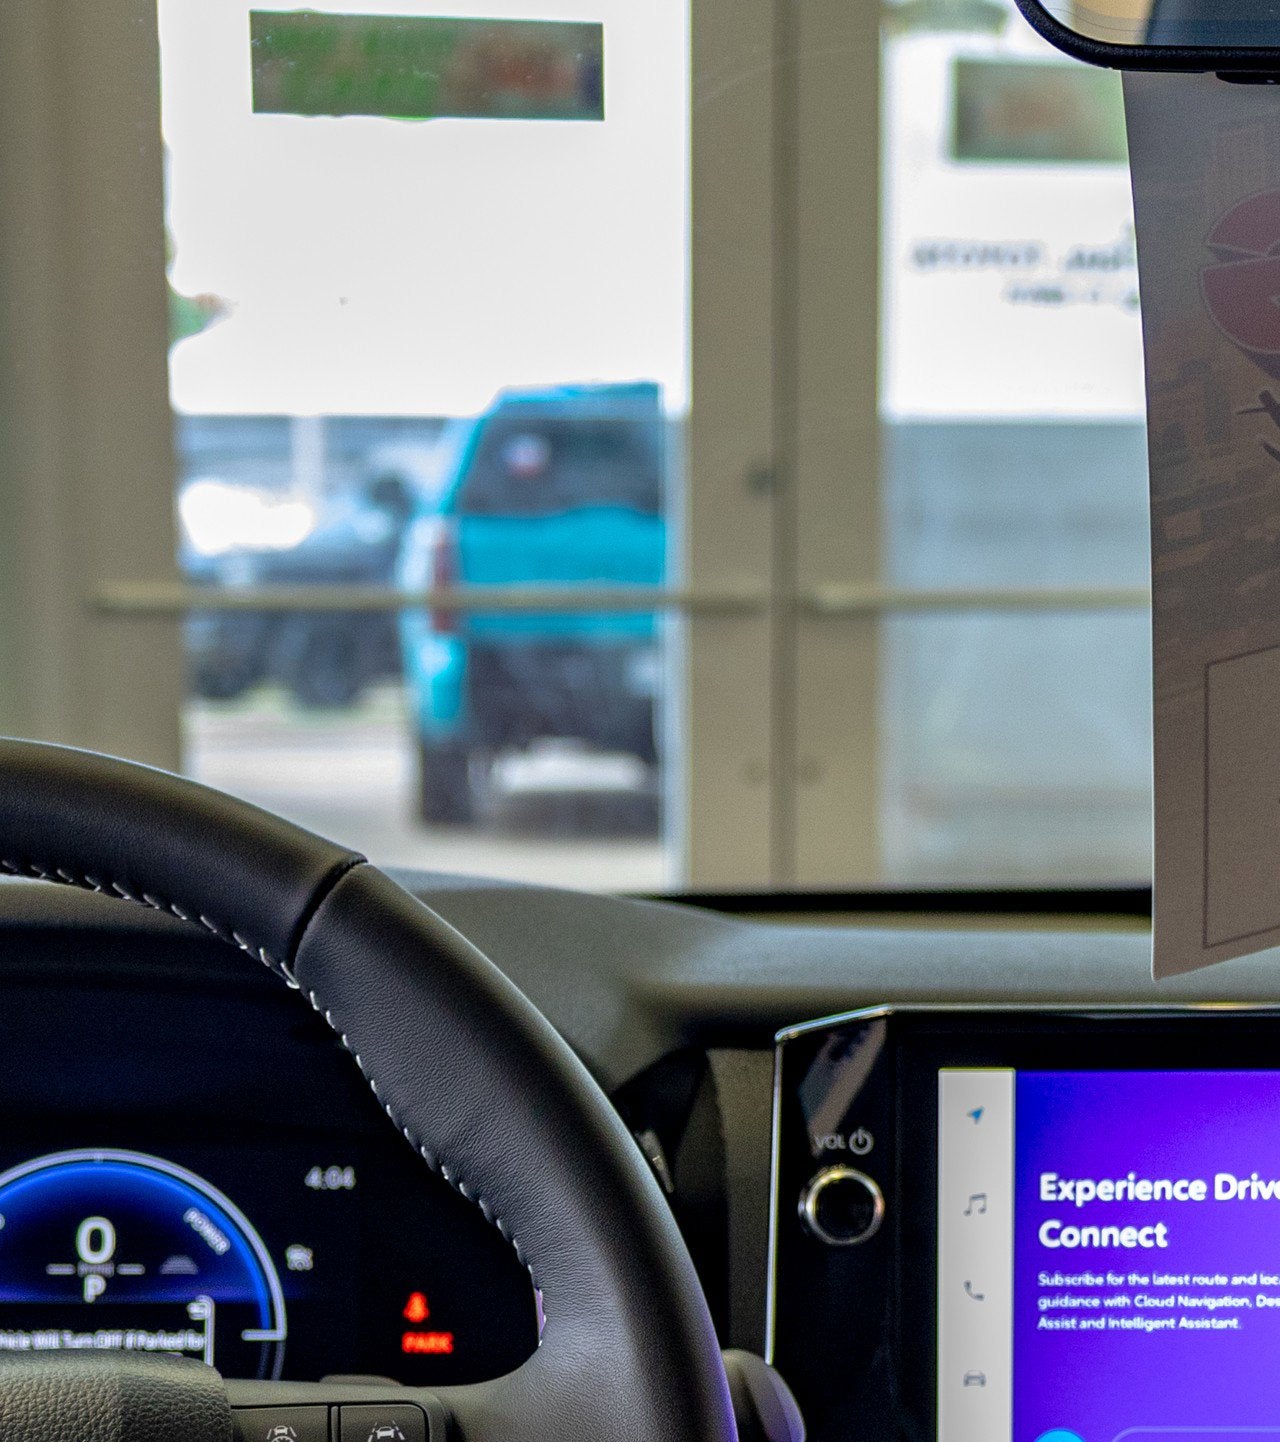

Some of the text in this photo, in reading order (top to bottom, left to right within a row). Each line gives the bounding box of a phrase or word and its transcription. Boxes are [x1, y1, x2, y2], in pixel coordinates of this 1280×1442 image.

[814, 1135, 846, 1150] VOL
[304, 1165, 356, 1190] 4:04
[1039, 1172, 1208, 1208] Experience
[75, 1216, 117, 1265] 0
[1038, 1218, 1169, 1249] Connect
[83, 1275, 107, 1304] P
[1038, 1271, 1104, 1286] Subscribe
[1106, 1271, 1125, 1286] for
[1127, 1272, 1150, 1286] the
[1152, 1272, 1190, 1286] latest
[1192, 1273, 1228, 1286] route
[1231, 1272, 1258, 1286] and
[1038, 1294, 1101, 1311] guidance
[1103, 1294, 1131, 1308] with
[1134, 1294, 1175, 1307] Cloud
[1038, 1315, 1077, 1330] Assist
[1079, 1315, 1106, 1330] and
[1108, 1316, 1176, 1333] Intelligent
[402, 1331, 454, 1354] PARK
